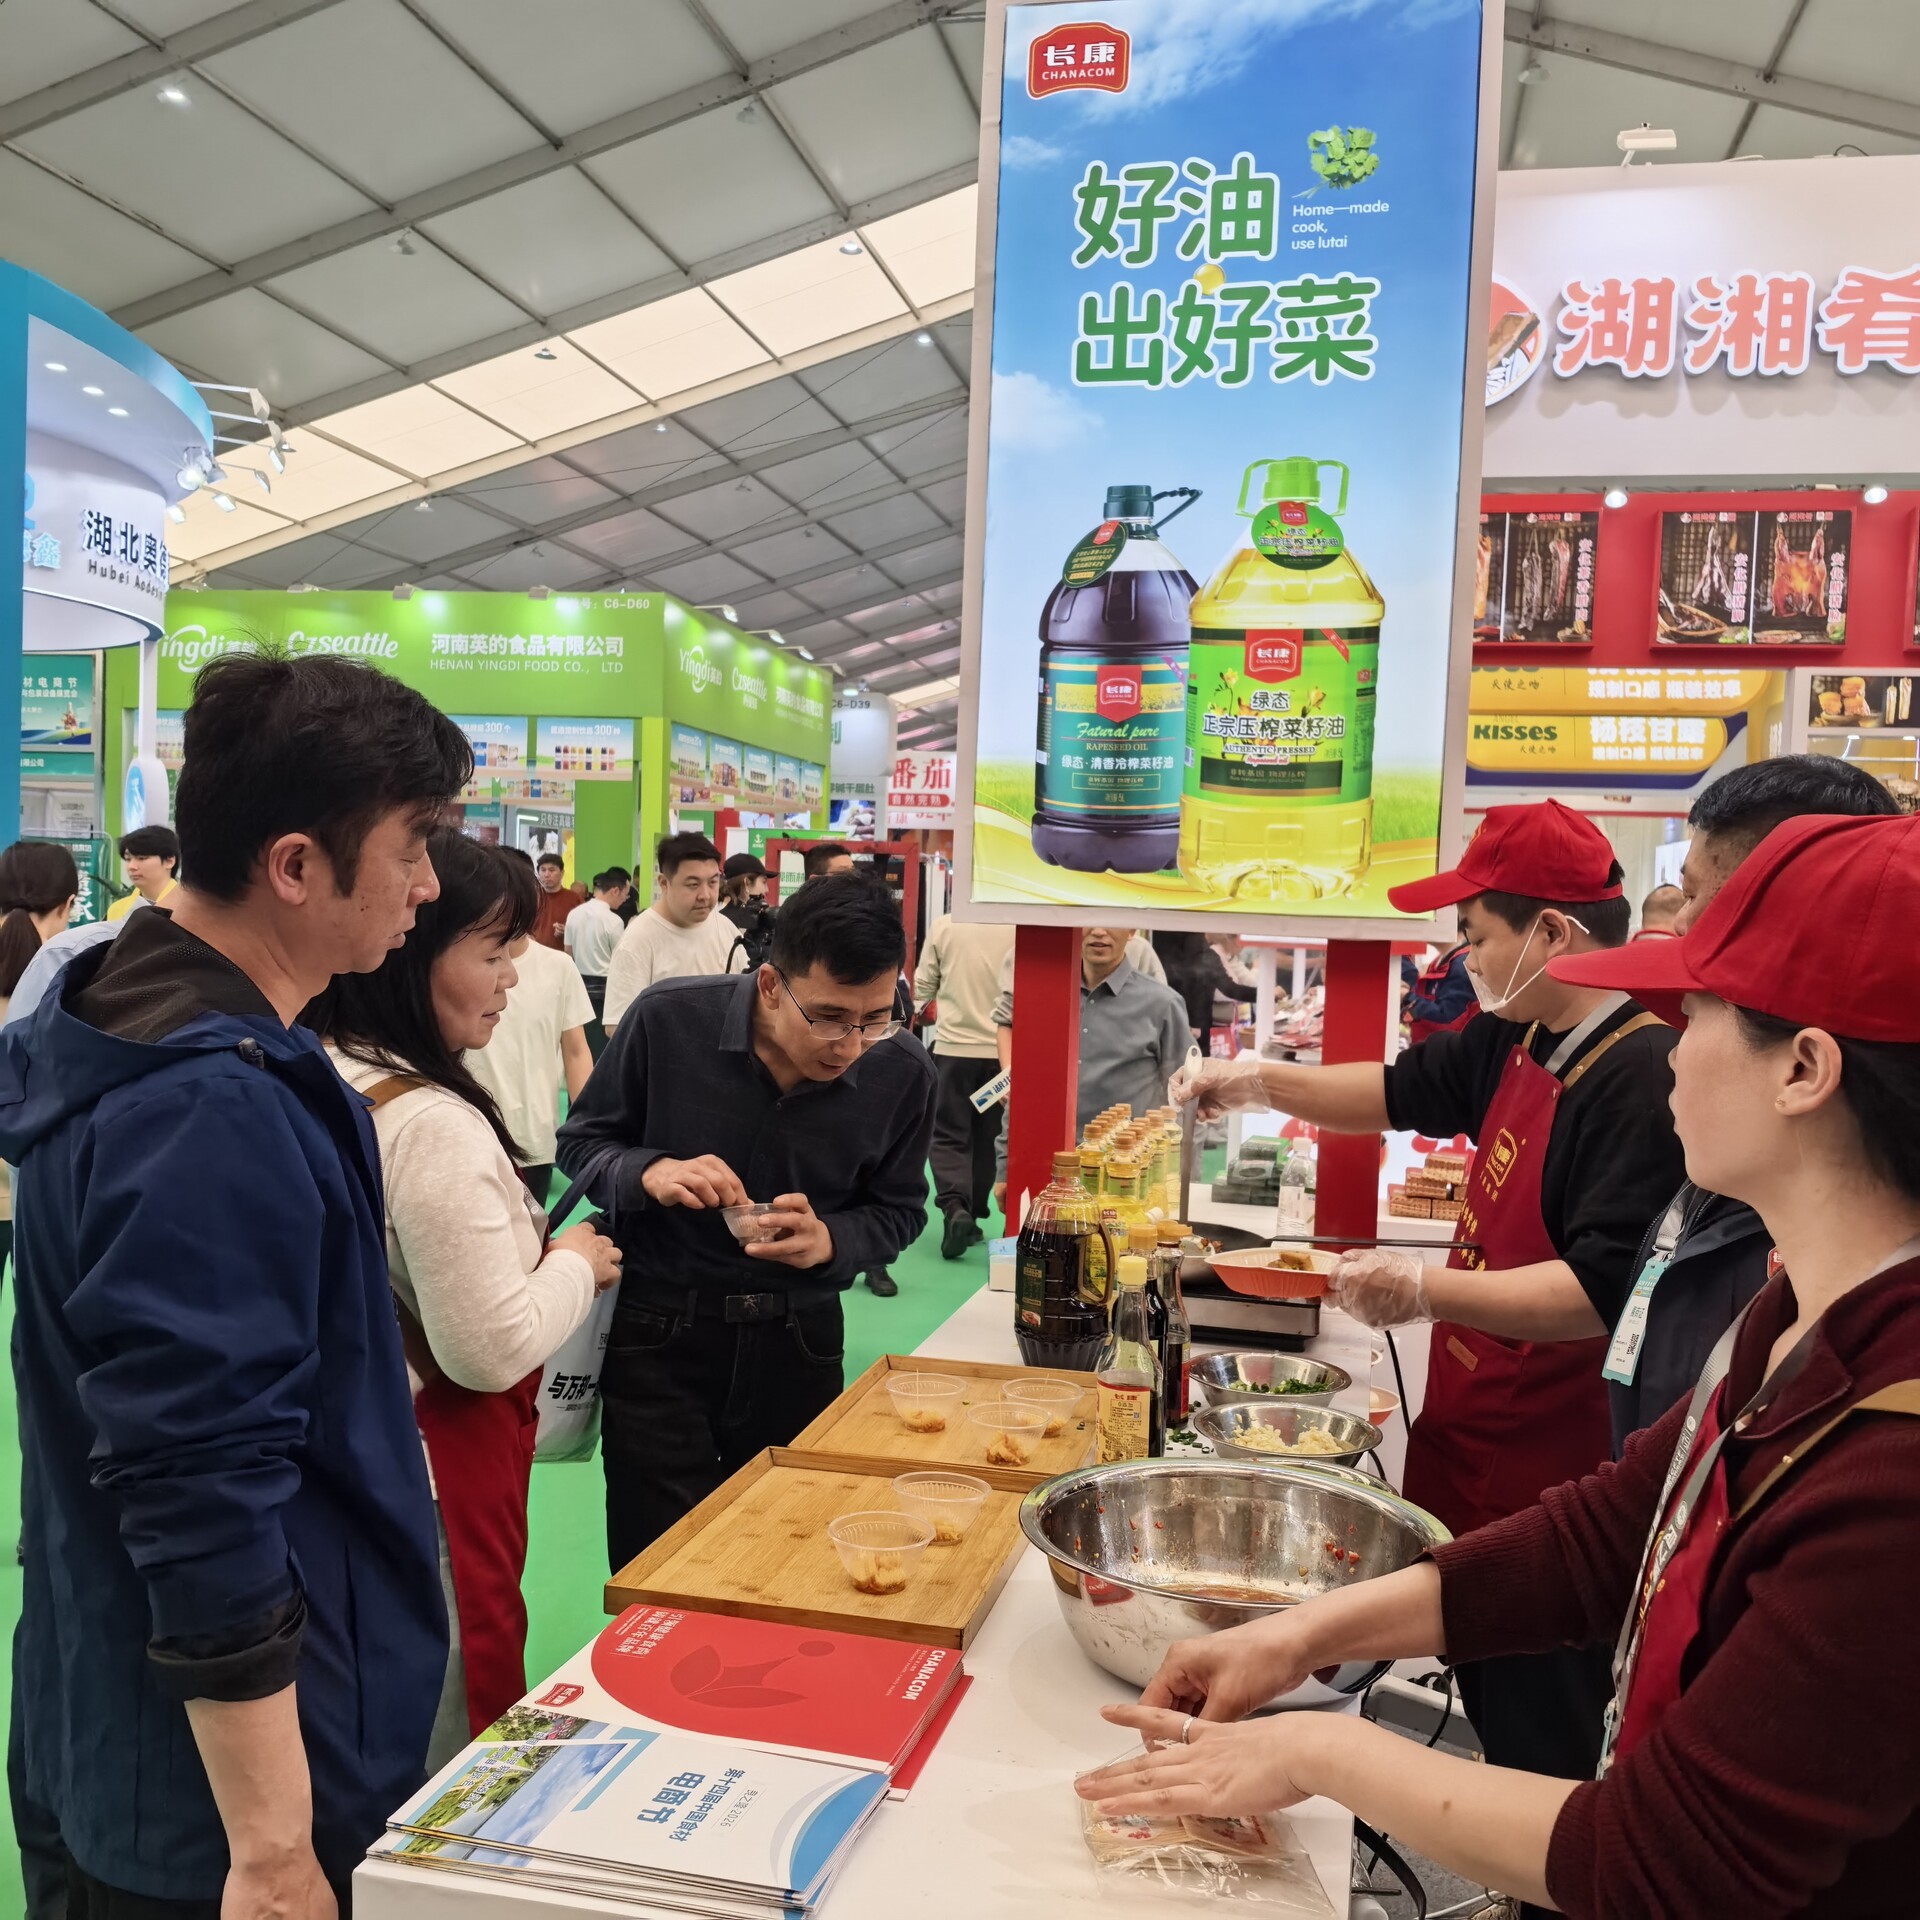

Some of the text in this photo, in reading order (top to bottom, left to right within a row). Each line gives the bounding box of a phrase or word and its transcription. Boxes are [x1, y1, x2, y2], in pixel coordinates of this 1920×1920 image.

[1043, 42, 1116, 66] 长康
[1042, 68, 1115, 80] CHANACOM
[1072, 152, 1279, 269] 好油
[1292, 220, 1328, 234] cook,
[1291, 235, 1348, 250] use lutai
[1072, 272, 1380, 390] 出好菜
[1553, 264, 1920, 378] 湖湘肴
[88, 559, 130, 585] Hubei
[604, 598, 650, 609] C6-D60
[431, 633, 624, 657] 河南英的食品有限公司
[1256, 648, 1291, 659] 长康
[430, 659, 473, 670] HENAN
[478, 660, 520, 671] YINGDI
[524, 661, 559, 672] FOOD
[601, 662, 623, 673] LTD
[1251, 689, 1291, 710] 绿态
[1129, 727, 1160, 740] pure
[1202, 715, 1346, 738] 正宗压榨菜籽油
[1086, 743, 1148, 751] RAPESEED OIL
[1223, 744, 1315, 754] AUTHENTIC PRESSED
[892, 758, 951, 790] 番茄
[901, 1650, 946, 1701] CHANACOM
[636, 1772, 706, 1824] 电商节
[669, 1768, 745, 1842] 第十四届中国食材
